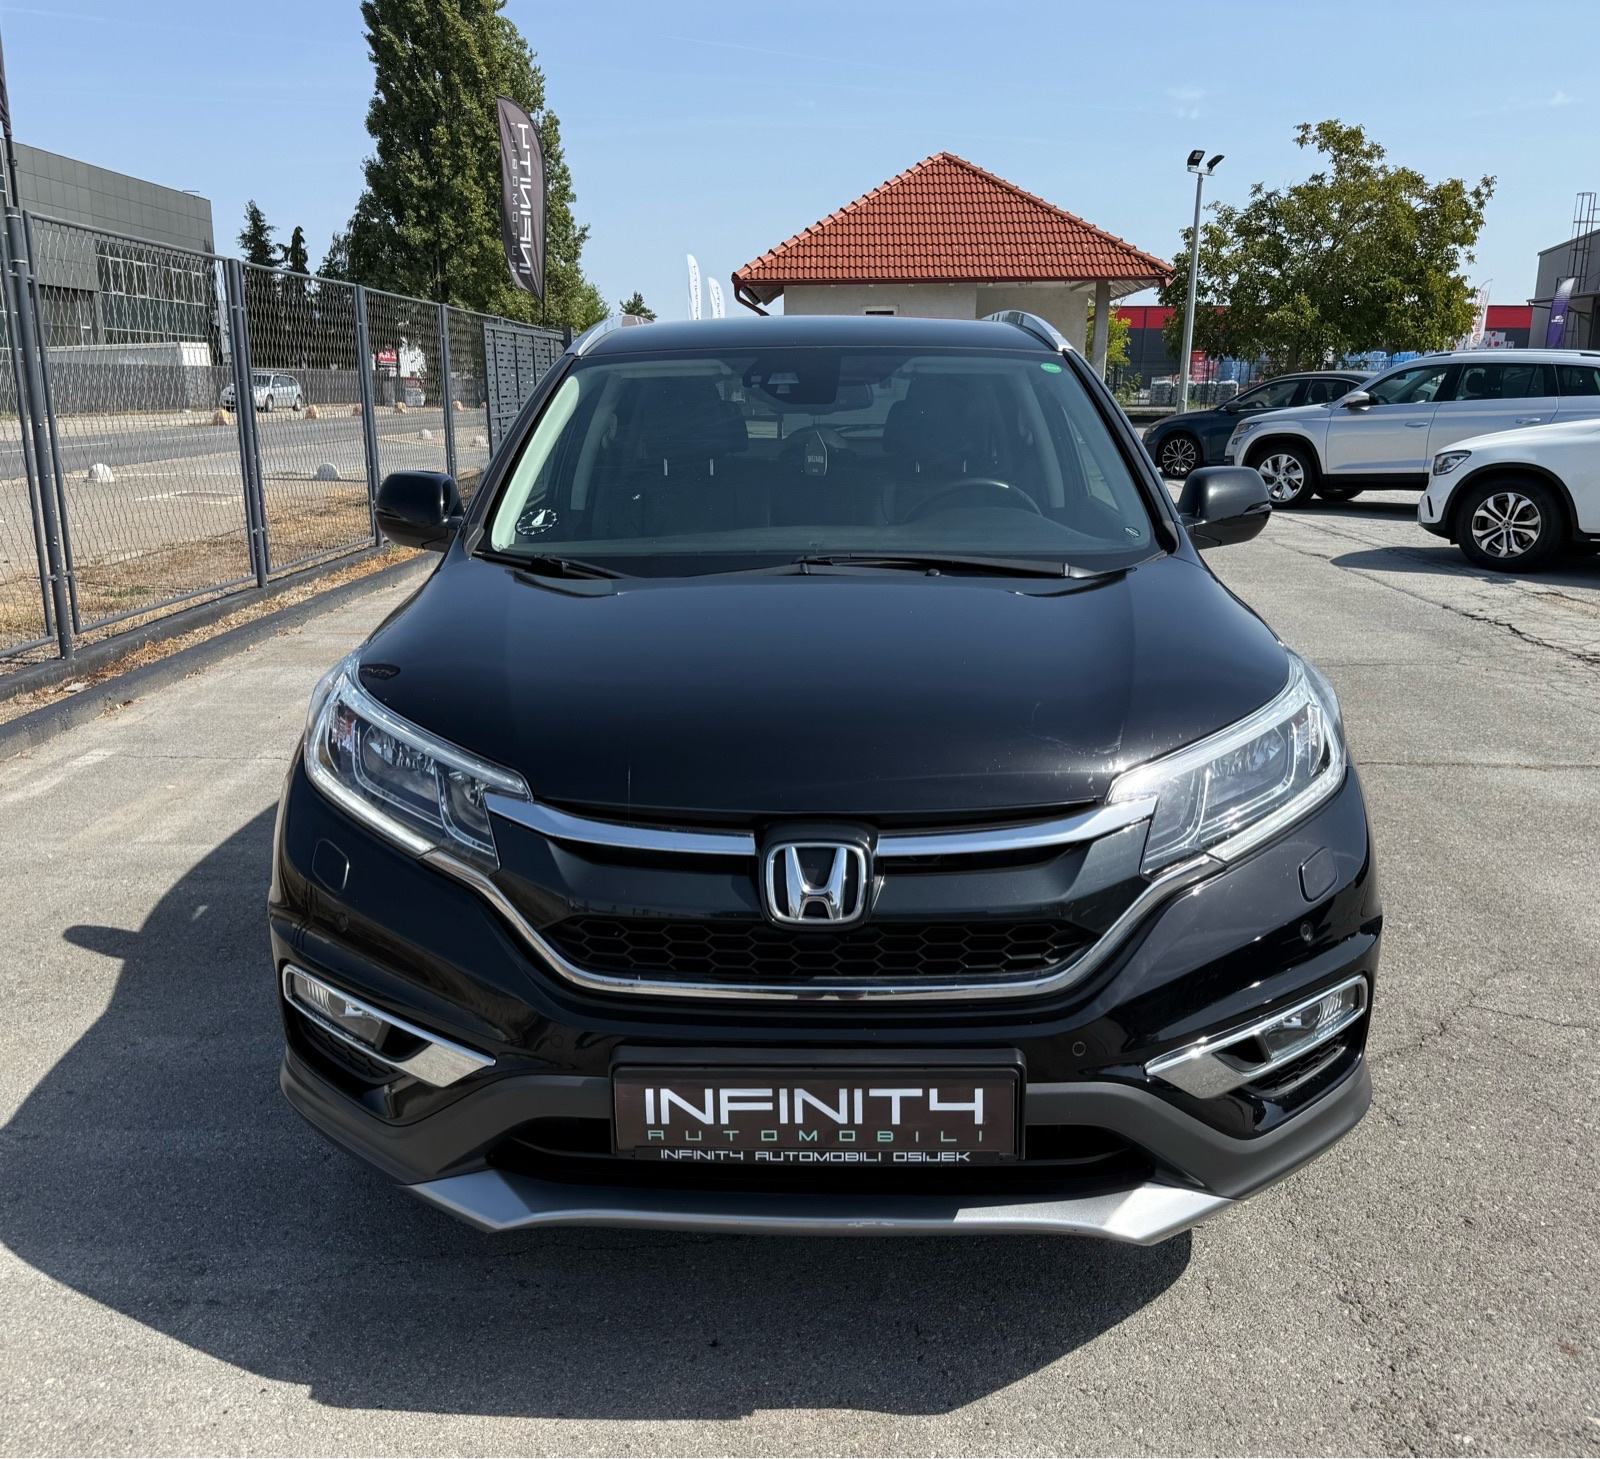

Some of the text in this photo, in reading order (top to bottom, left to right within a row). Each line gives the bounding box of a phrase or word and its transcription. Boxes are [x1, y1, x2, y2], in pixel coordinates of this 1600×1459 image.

[645, 1088, 983, 1125] INFINIT4
[647, 1130, 983, 1142] AUTOMOBILI
[660, 1149, 970, 1163] INFINIT4 AUTOMOBILI OSIJEK
